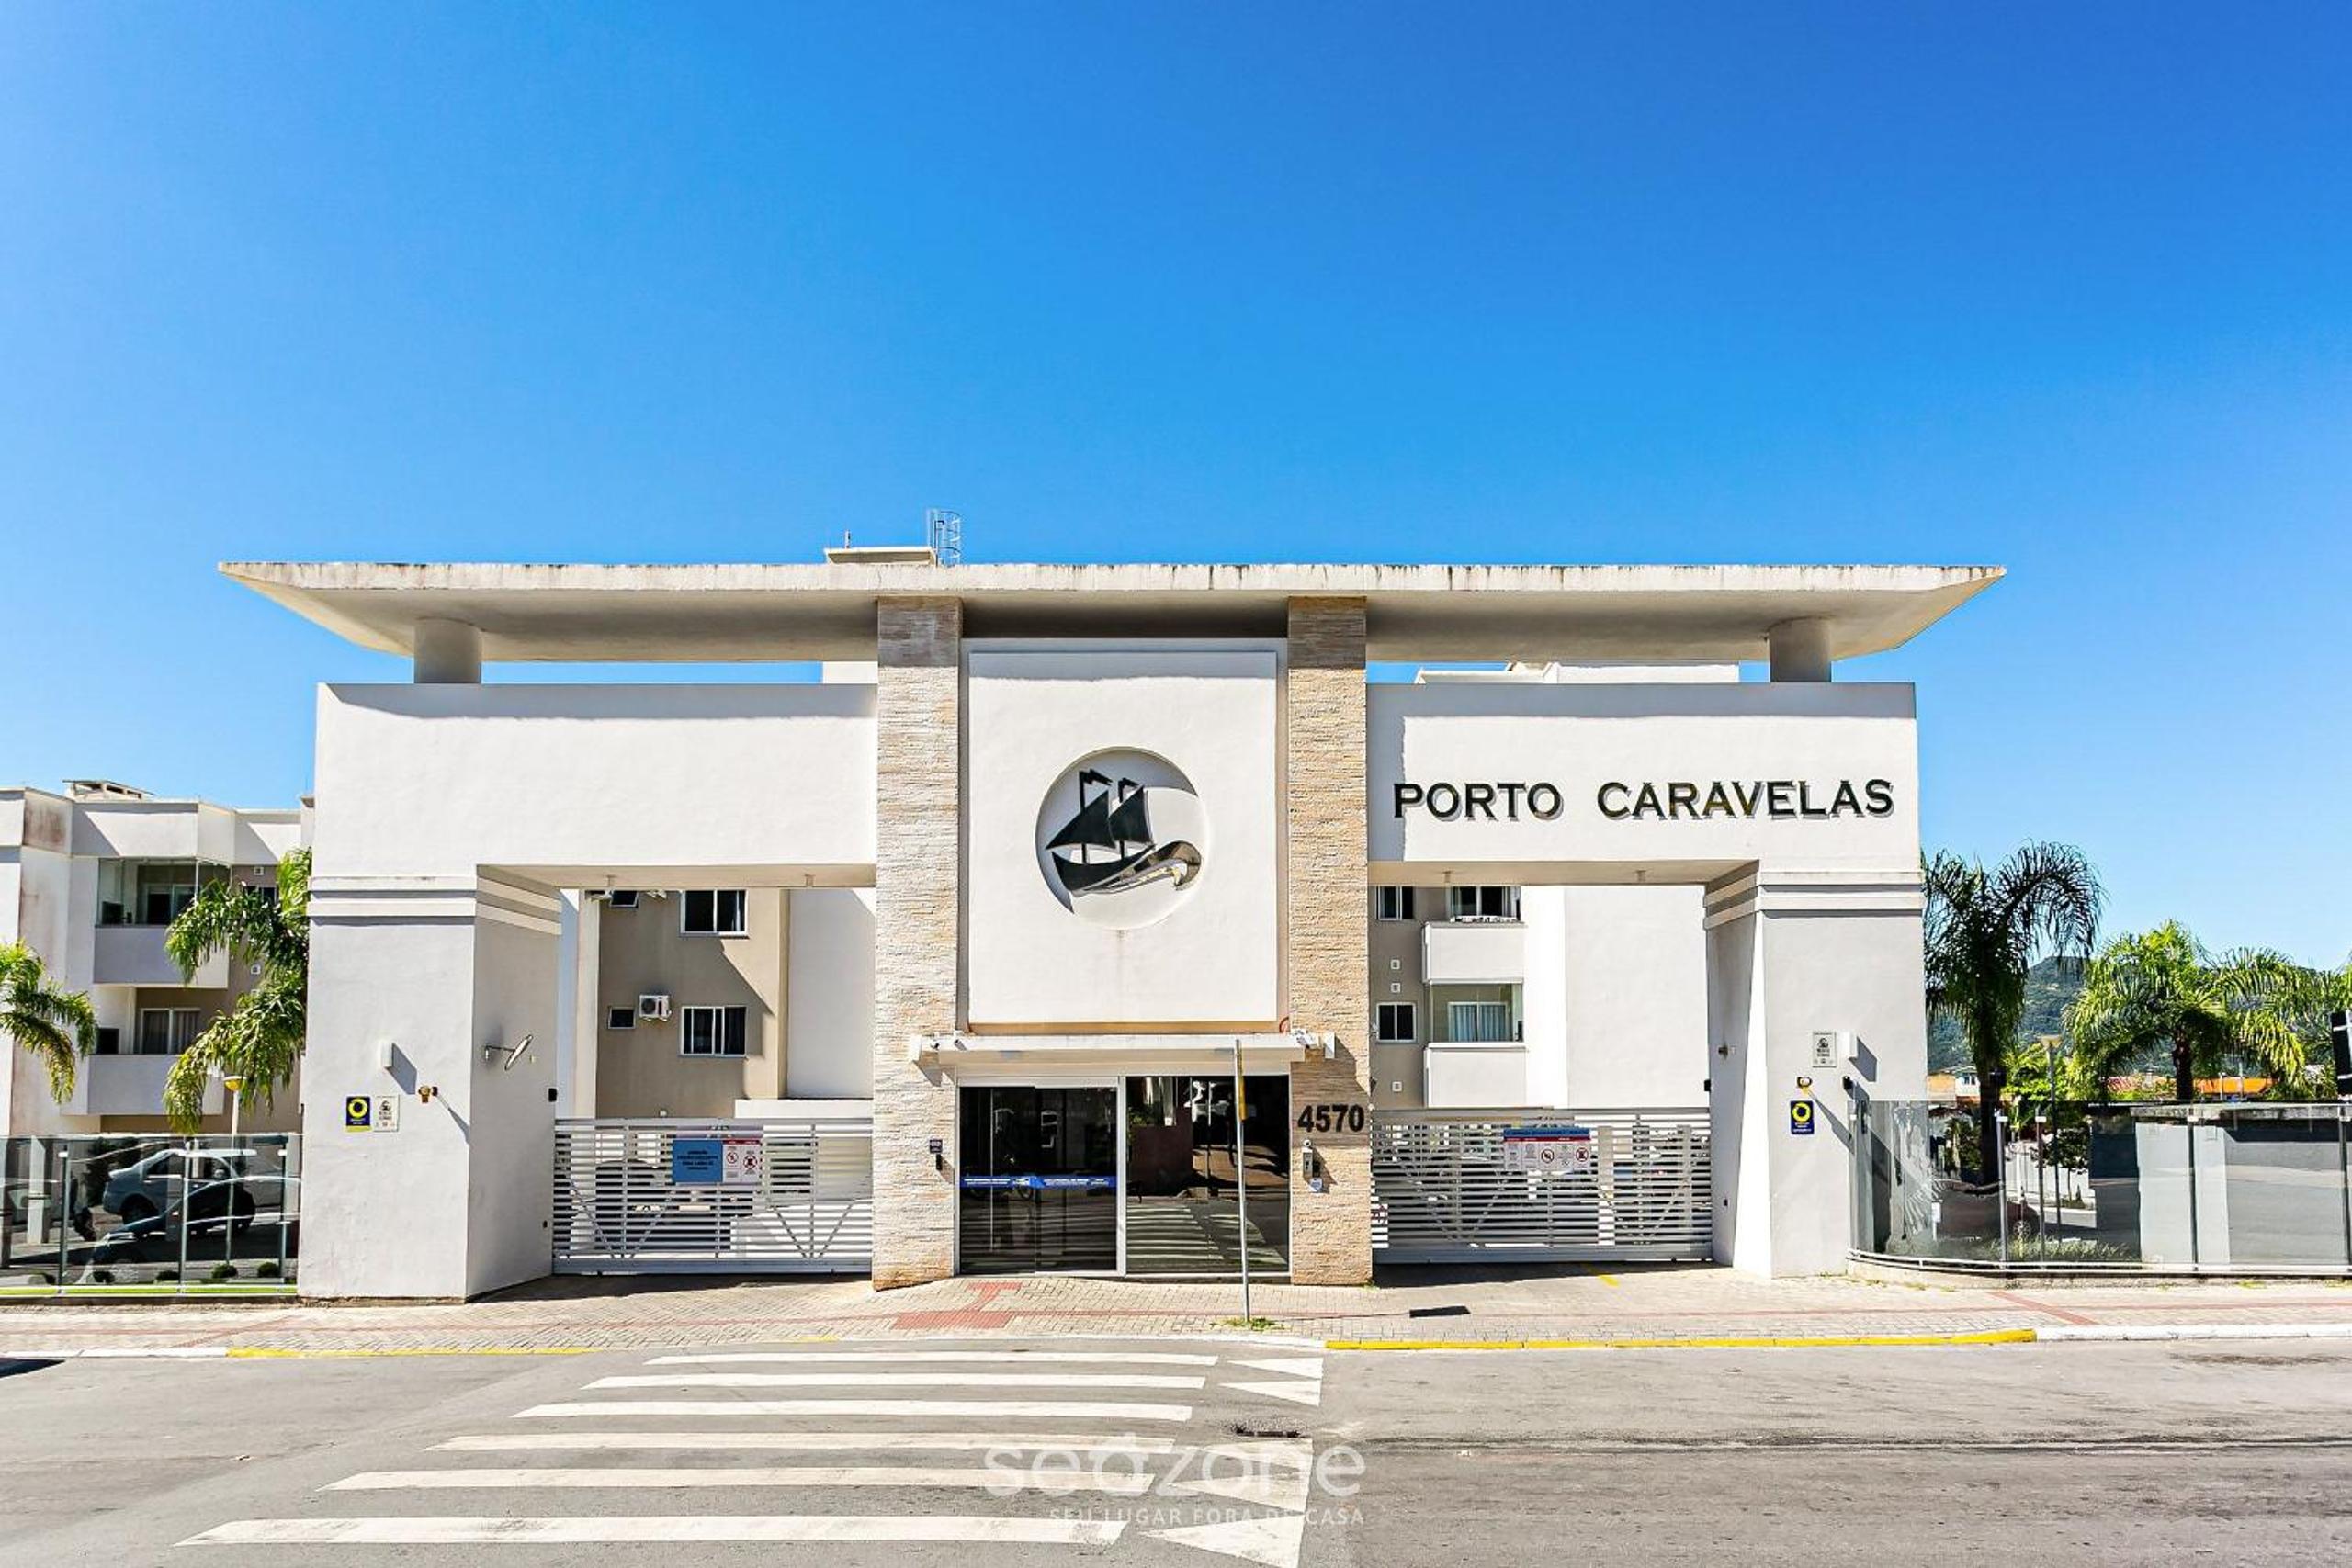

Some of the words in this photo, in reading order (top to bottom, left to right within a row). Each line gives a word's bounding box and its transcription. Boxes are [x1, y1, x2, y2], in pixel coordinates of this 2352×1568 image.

[1394, 783, 1561, 819] PORTO
[1597, 778, 1894, 819] CARAVELAS
[1298, 1104, 1365, 1133] 4570
